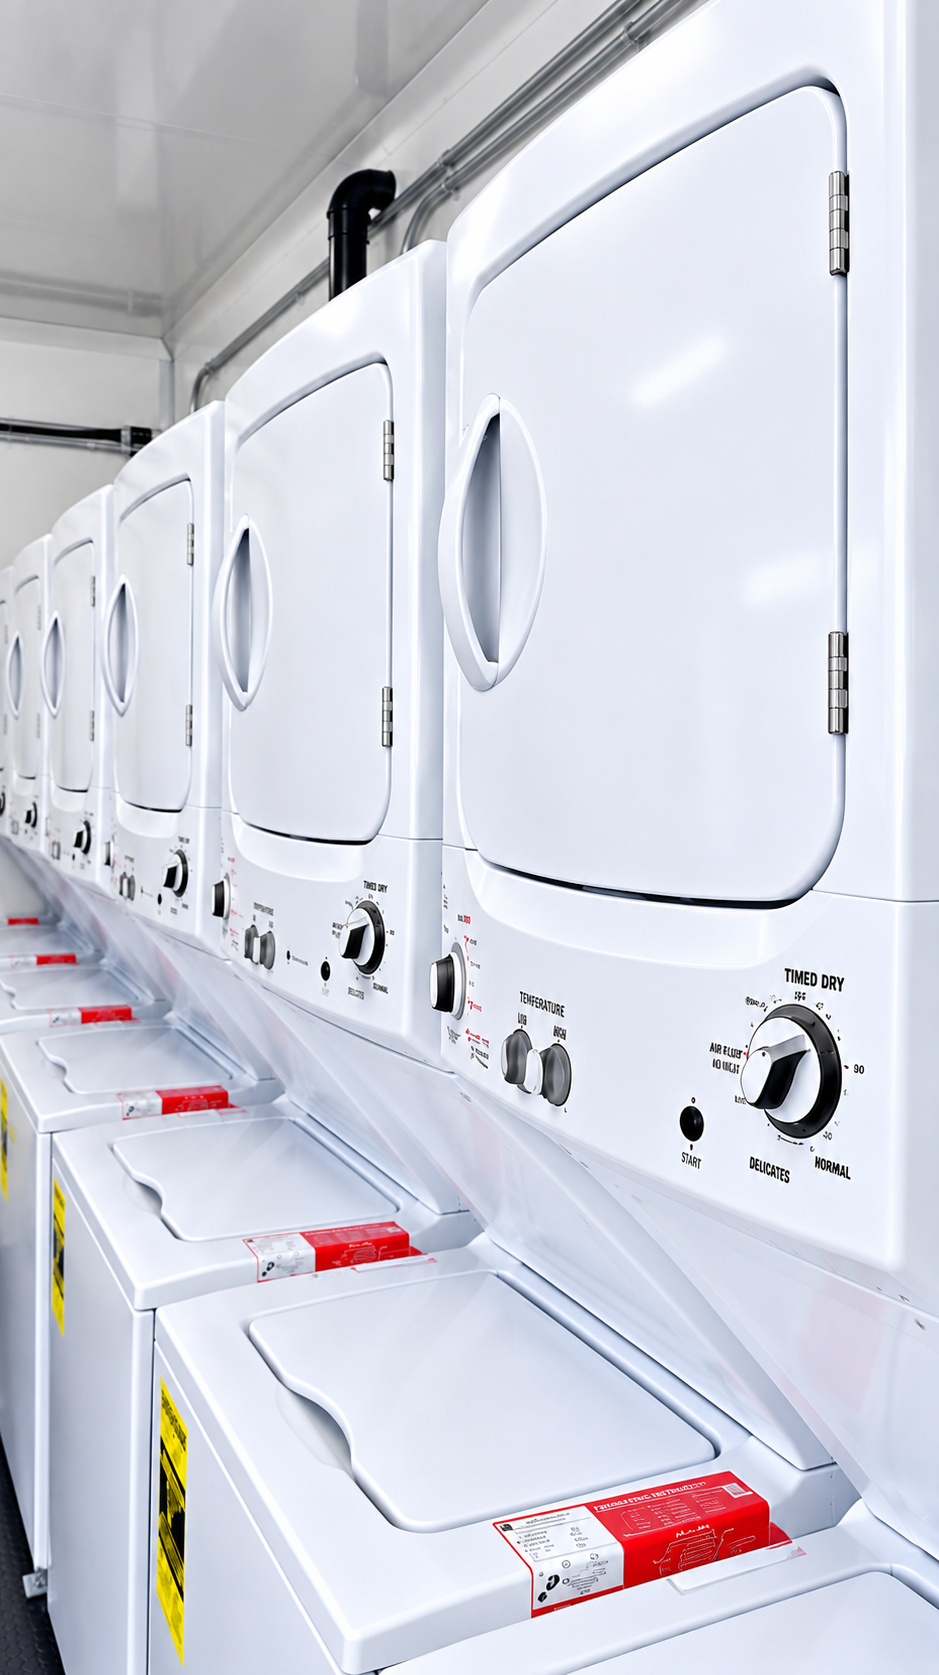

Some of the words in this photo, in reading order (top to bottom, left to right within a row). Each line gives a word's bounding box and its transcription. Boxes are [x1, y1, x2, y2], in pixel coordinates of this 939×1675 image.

[784, 967, 818, 987] TIMED
[821, 974, 845, 992] DRY
[853, 1063, 865, 1075] 90
[681, 1151, 702, 1169] START
[749, 1156, 791, 1184] DELICATES
